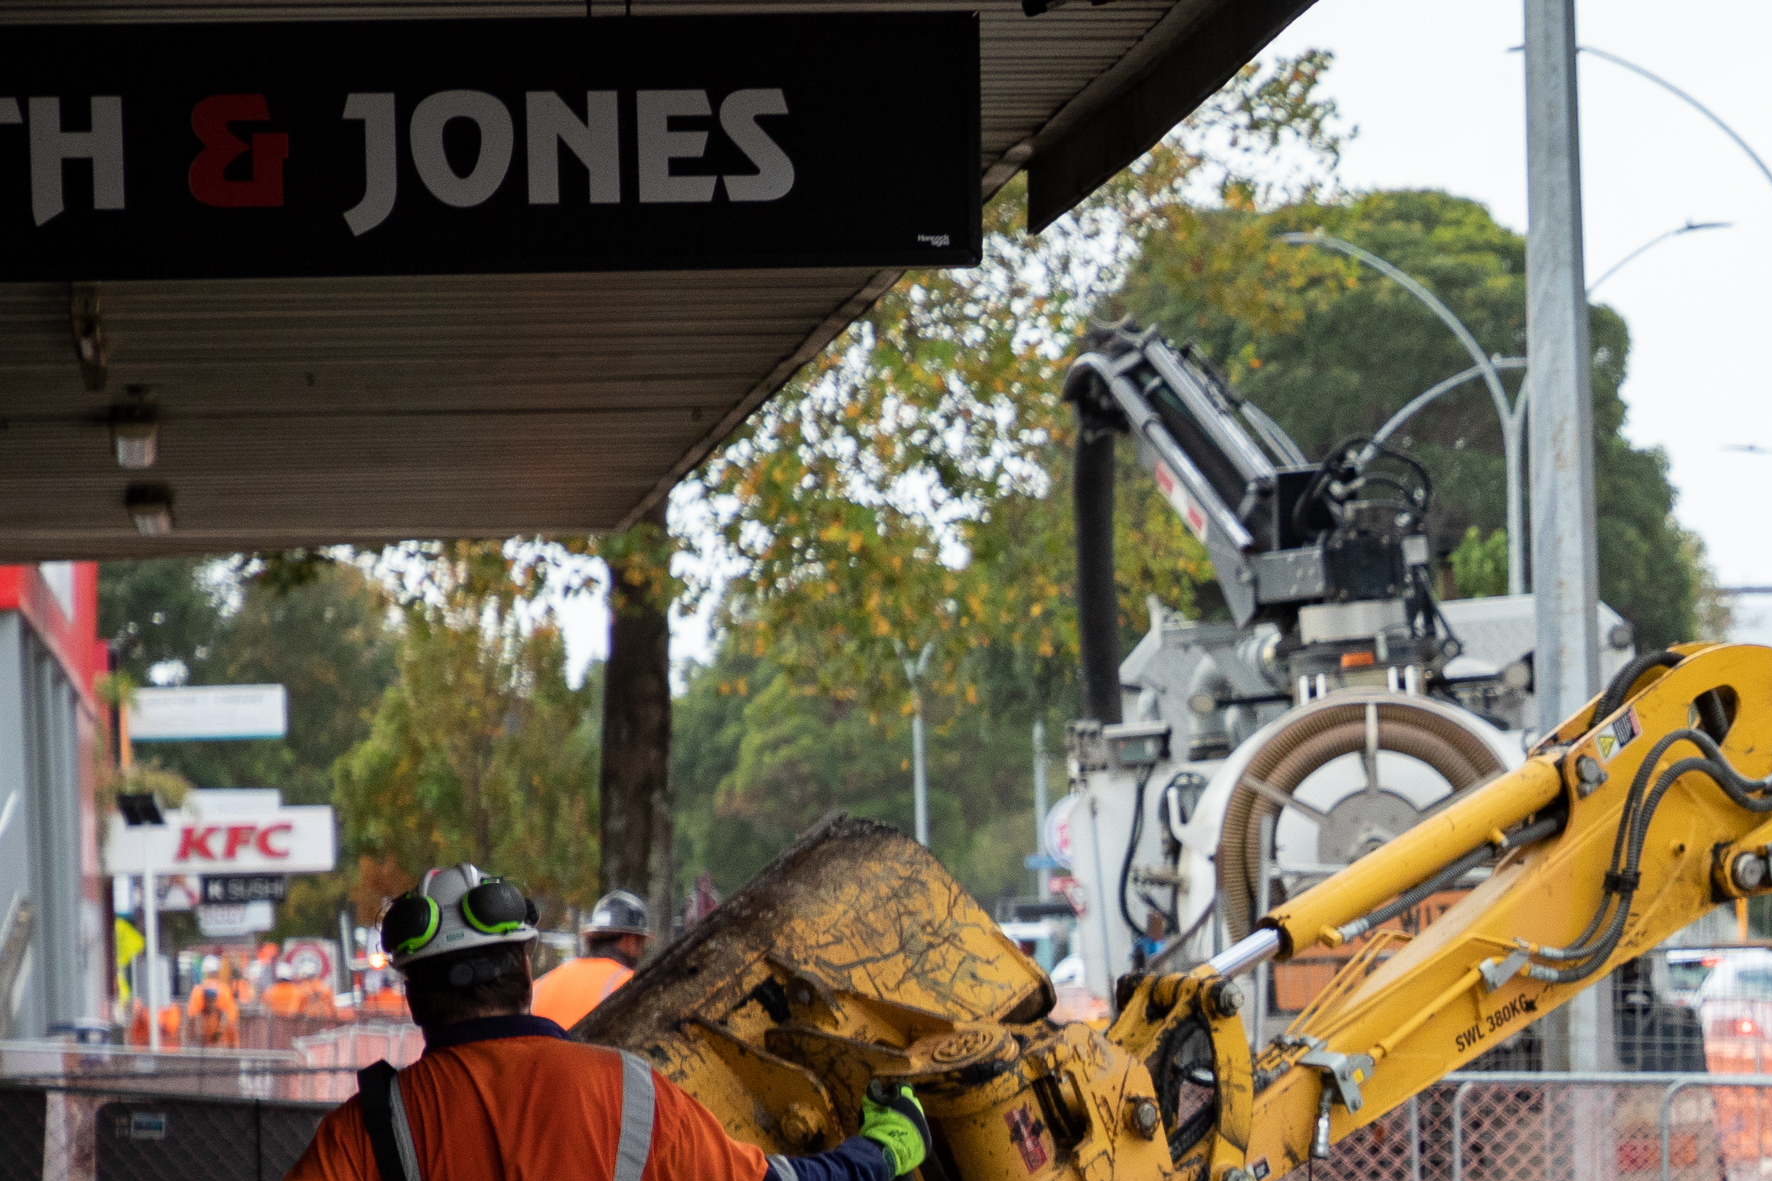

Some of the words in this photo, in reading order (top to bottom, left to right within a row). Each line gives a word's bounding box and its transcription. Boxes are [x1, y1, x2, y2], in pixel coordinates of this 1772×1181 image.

[0, 95, 127, 228] H
[188, 93, 289, 208] &
[342, 88, 796, 237] JONES
[175, 822, 293, 861] KFC
[1455, 1023, 1485, 1053] SWL
